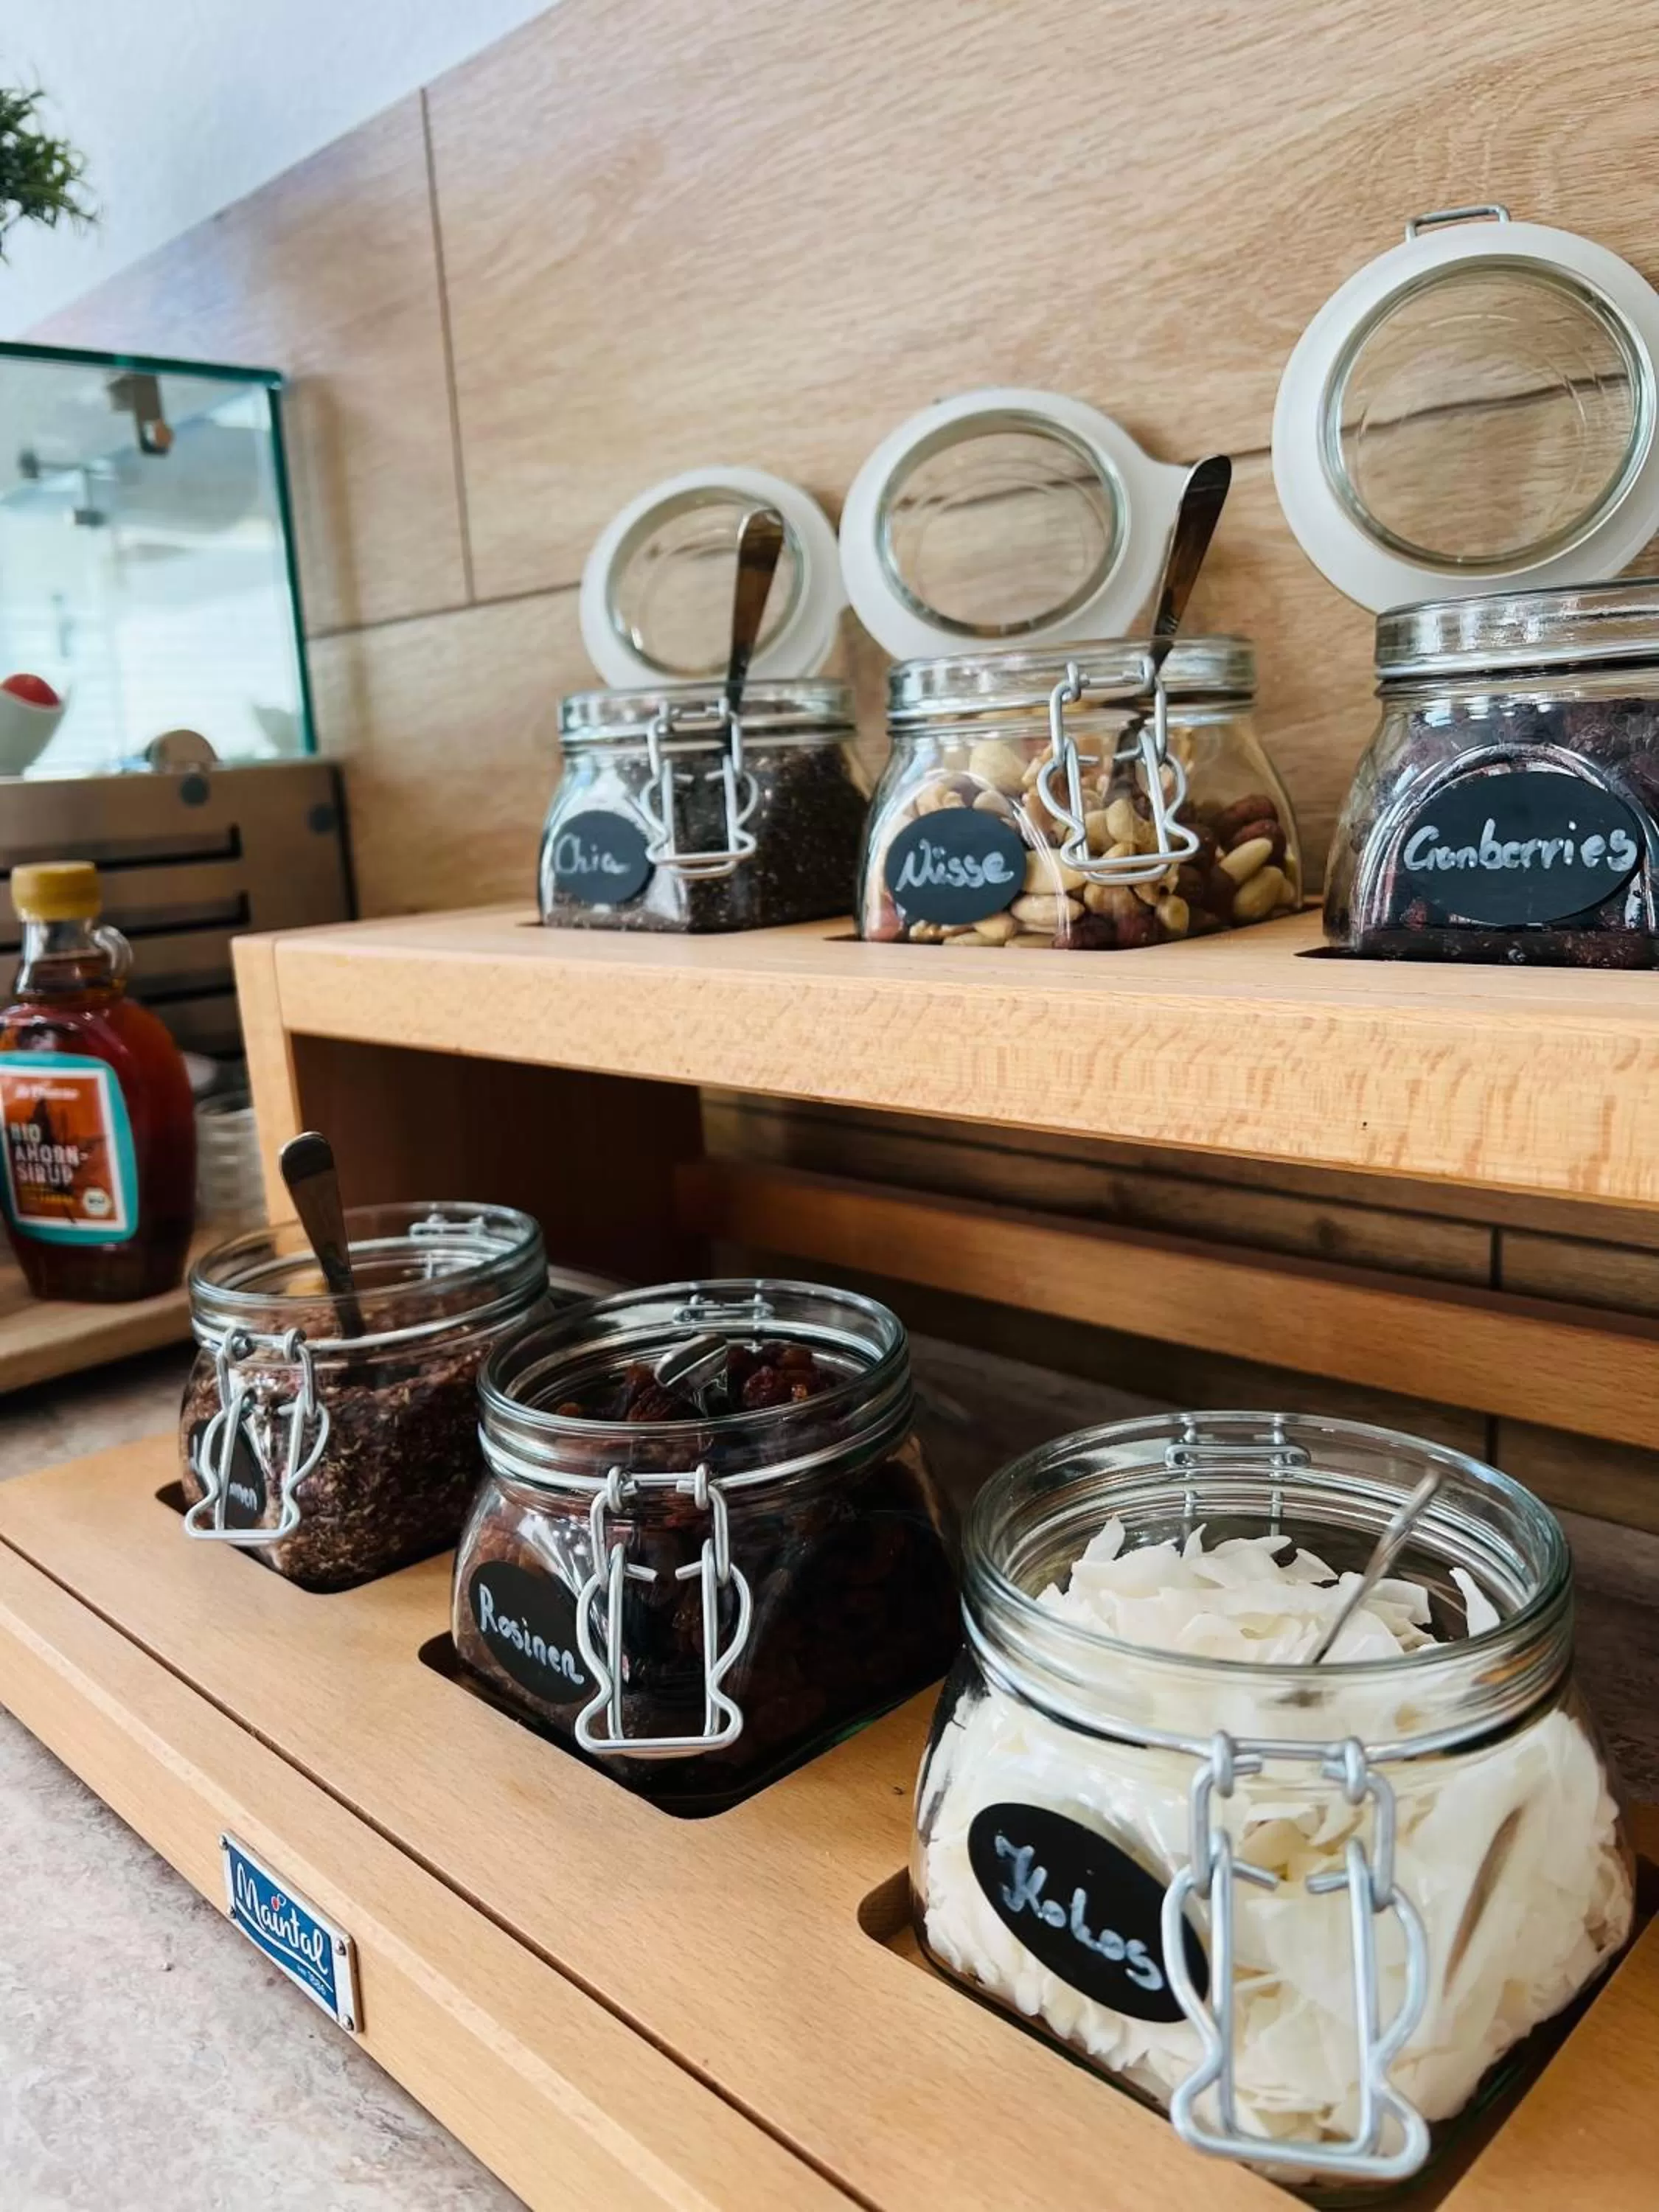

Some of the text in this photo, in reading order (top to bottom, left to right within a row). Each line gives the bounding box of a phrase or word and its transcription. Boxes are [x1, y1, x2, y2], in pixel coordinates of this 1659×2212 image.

[554, 832, 632, 874] Chia
[895, 838, 1015, 892] Nüsse
[1403, 818, 1638, 872] Cranberries
[10, 1122, 41, 1144] BIO
[16, 1164, 74, 1186] SIRUP
[479, 1583, 585, 1685] Rosinen
[237, 1863, 328, 1975] Maintal
[995, 1834, 1164, 1990] Kokos
